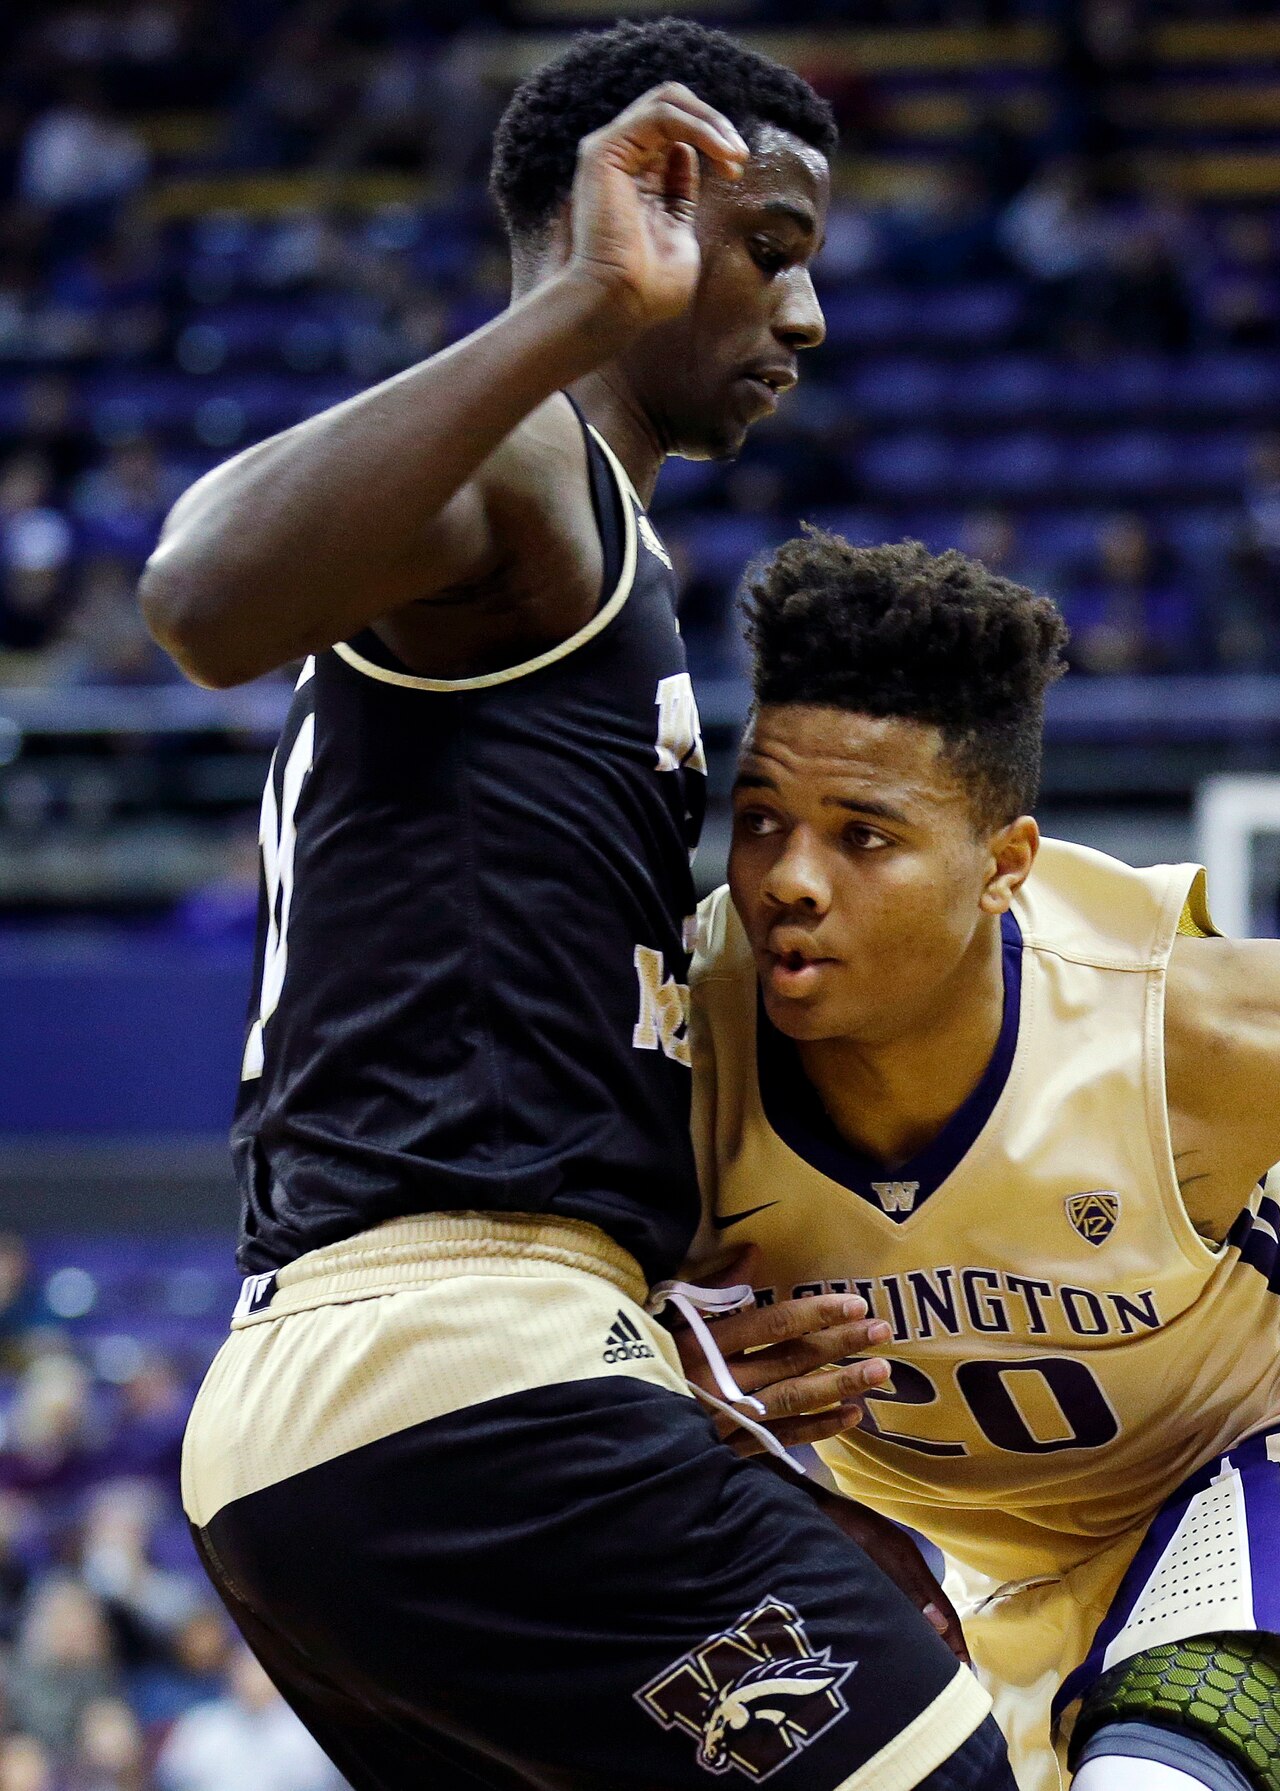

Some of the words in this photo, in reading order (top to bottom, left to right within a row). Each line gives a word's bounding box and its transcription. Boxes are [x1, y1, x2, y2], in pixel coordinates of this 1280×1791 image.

[870, 1181, 920, 1212] W
[1083, 1216, 1110, 1238] 12
[703, 1266, 1168, 1346] INGTON
[836, 1354, 1125, 1458] 20
